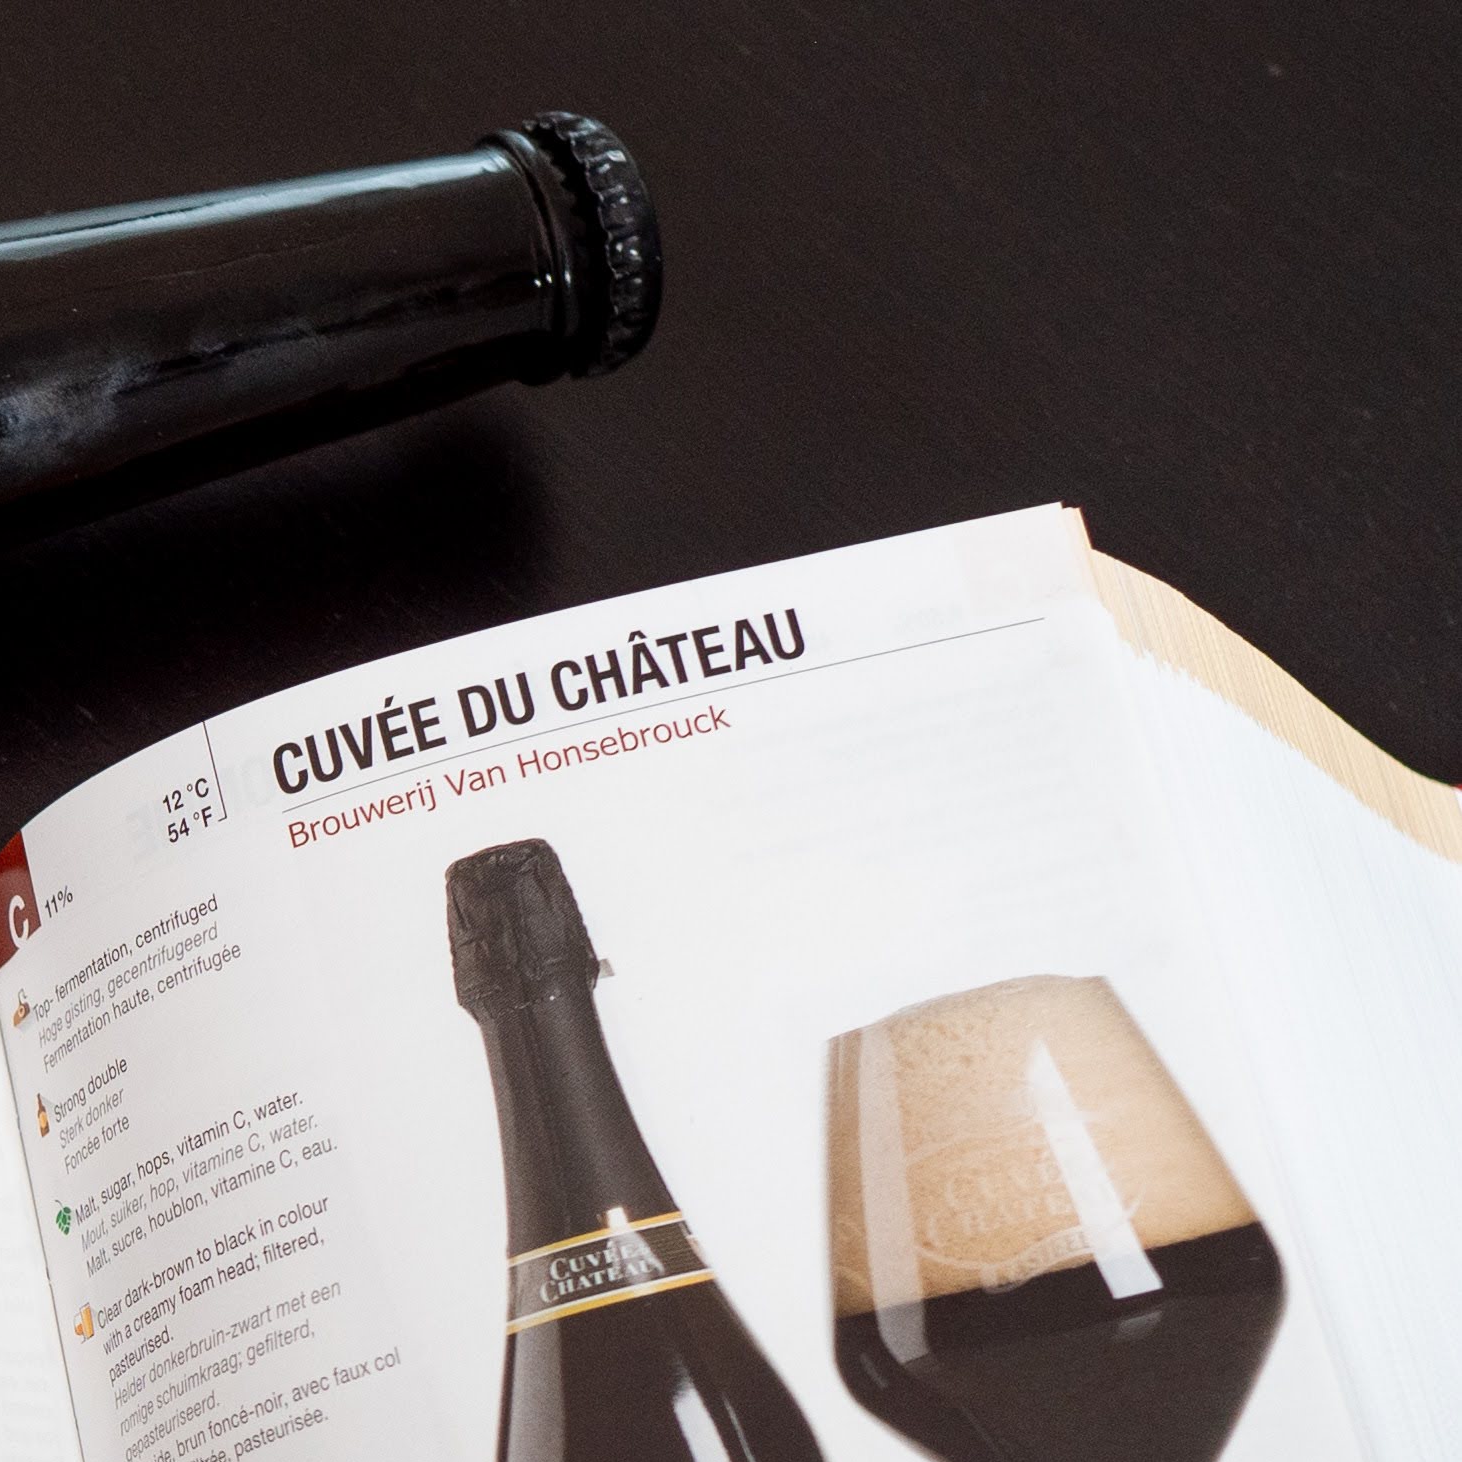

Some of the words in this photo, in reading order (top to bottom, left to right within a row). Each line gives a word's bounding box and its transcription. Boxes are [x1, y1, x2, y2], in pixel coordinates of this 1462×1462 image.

[272, 696, 447, 795] CUVÉE
[457, 671, 536, 738] DU
[549, 607, 807, 712] CHÂTEAU
[163, 790, 184, 813] 12
[186, 777, 211, 799] °C
[287, 777, 438, 849] Brouwerij
[444, 759, 507, 798] Van
[516, 704, 732, 779] Honsebrouck
[168, 818, 190, 843] 54
[193, 807, 214, 828] °F
[7, 894, 30, 951] C
[44, 886, 74, 919] 11%
[33, 999, 54, 1023] Top-
[55, 943, 132, 1001] fermentation,
[136, 893, 218, 948] centrifuged
[53, 1087, 87, 1124] Strong
[88, 1059, 127, 1094] double
[75, 1197, 100, 1227] Malt,
[101, 1173, 135, 1204] sugar,
[136, 1151, 174, 1179] hops,
[176, 1121, 229, 1156] vitamin
[233, 1110, 250, 1129] C,
[254, 1092, 303, 1120] water.
[97, 1299, 123, 1330] Clear
[125, 1256, 194, 1308] dark-brown
[196, 1248, 211, 1264] to
[214, 1225, 256, 1256] black
[258, 1219, 274, 1236] in
[278, 1197, 328, 1228] colour
[104, 1331, 123, 1355] with
[125, 1325, 132, 1339] a
[134, 1295, 175, 1332] creamy
[179, 1276, 215, 1304] foam
[217, 1253, 260, 1284] head;
[263, 1227, 324, 1264] filtered,
[109, 1325, 174, 1387] pasteurised.
